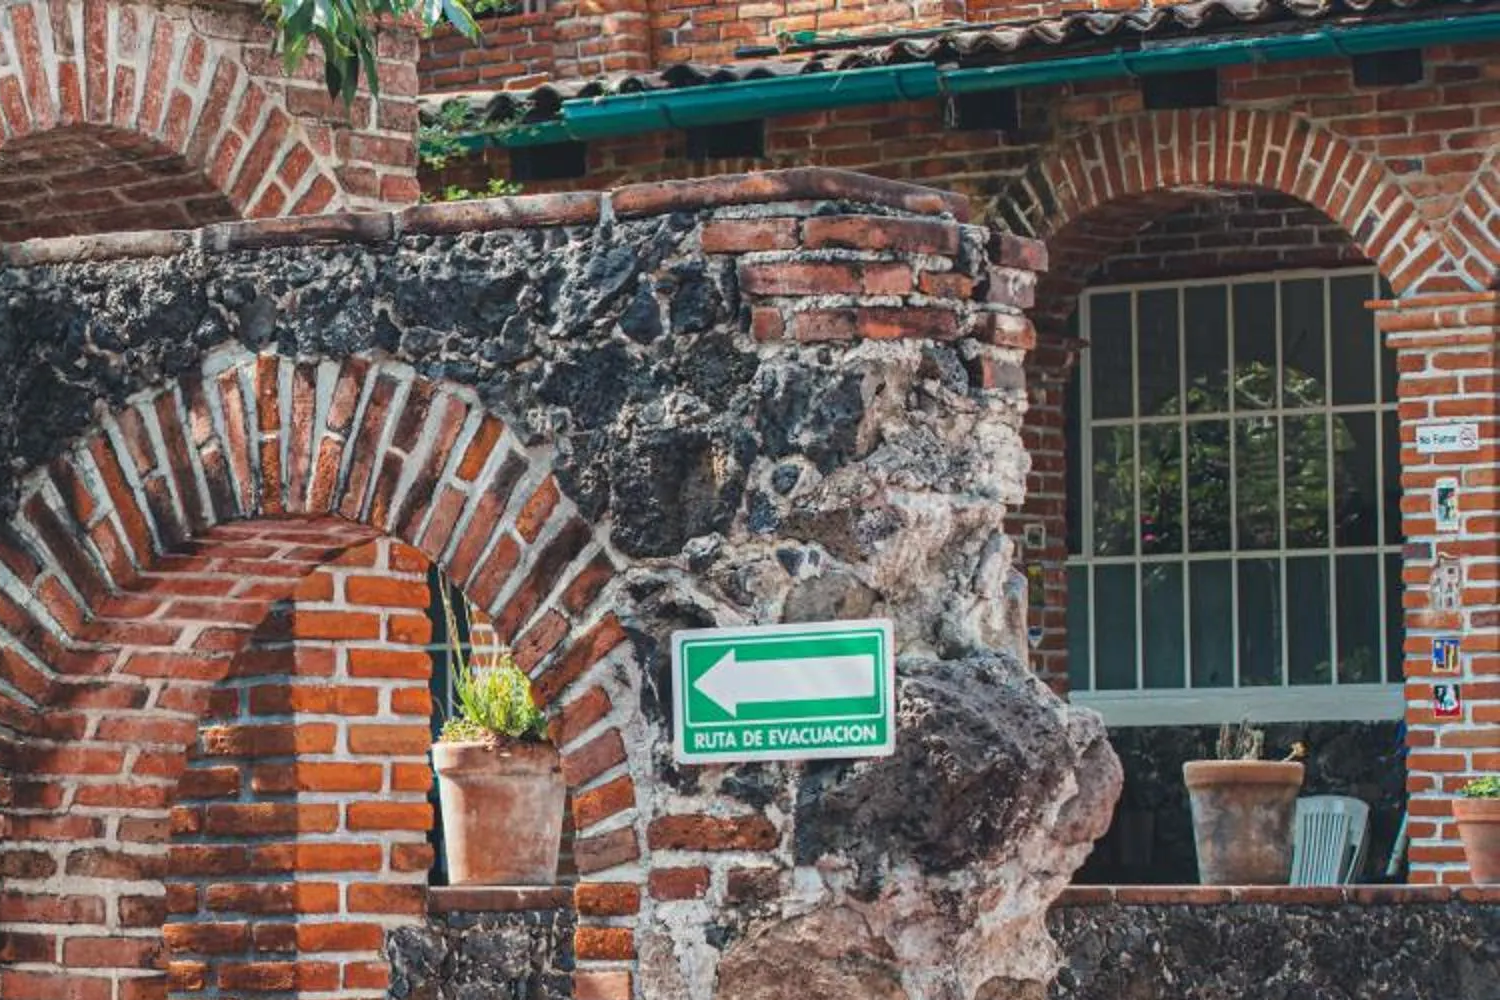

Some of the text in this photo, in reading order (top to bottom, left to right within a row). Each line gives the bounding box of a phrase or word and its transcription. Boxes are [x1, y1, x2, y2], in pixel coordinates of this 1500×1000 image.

[694, 724, 877, 749] RUTA DE EVACUACION
